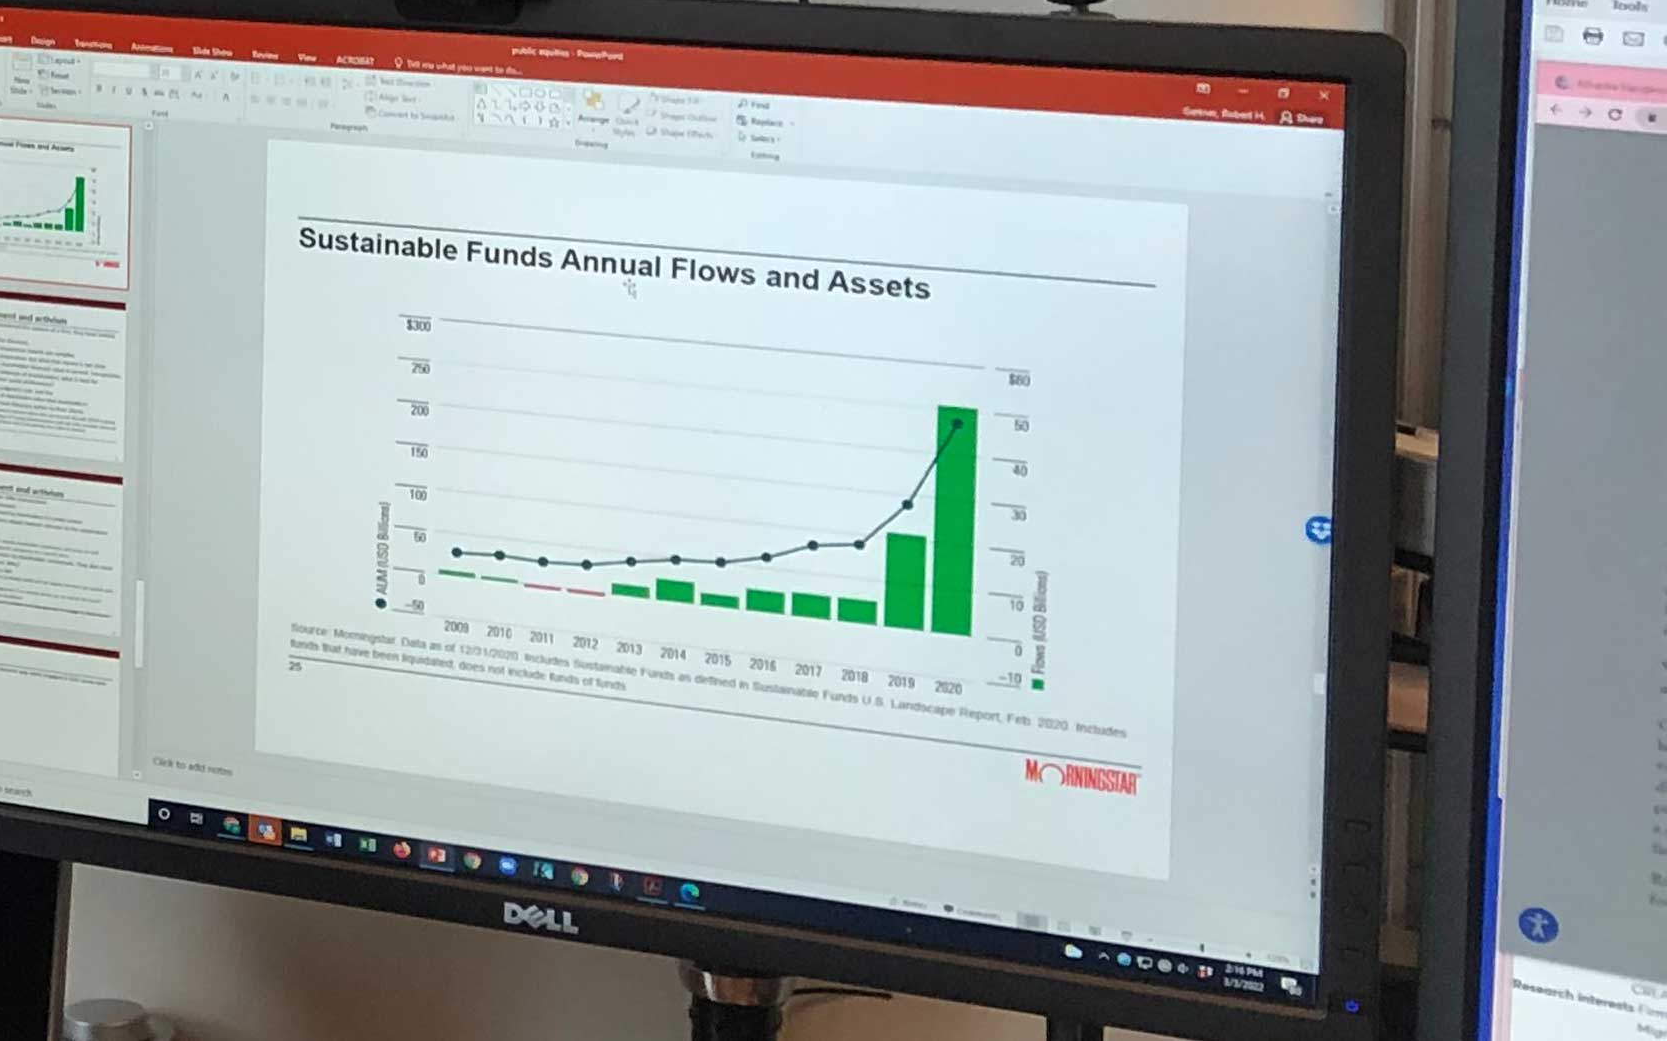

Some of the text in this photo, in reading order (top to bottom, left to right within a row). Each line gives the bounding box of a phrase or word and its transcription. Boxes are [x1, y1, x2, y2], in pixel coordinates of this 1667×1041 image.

[1612, 0, 1649, 12] Tools
[298, 225, 932, 302] Sustainable Funds Annual Flows and Assets
[406, 319, 432, 332] $300
[411, 362, 431, 375] 250
[410, 404, 429, 417] 200
[410, 446, 429, 459] 150
[1012, 464, 1028, 478] 40
[409, 489, 428, 502] 100
[1010, 508, 1027, 522] 30
[413, 531, 427, 544] 50
[1010, 553, 1025, 567] 20
[1009, 599, 1024, 613] 10
[290, 638, 594, 686] funds that have been does not include funds of
[443, 619, 963, 696] 2009 2010 2011 2012 2013 2014 2015 2016 2017 2018 2019 2020
[401, 634, 1128, 740] Data as of Sustainable Funds as defined Sustainable Funds Landscape Includes
[152, 755, 205, 775] Click to add
[503, 901, 580, 935] DELL
[1512, 978, 1575, 1002] Research
